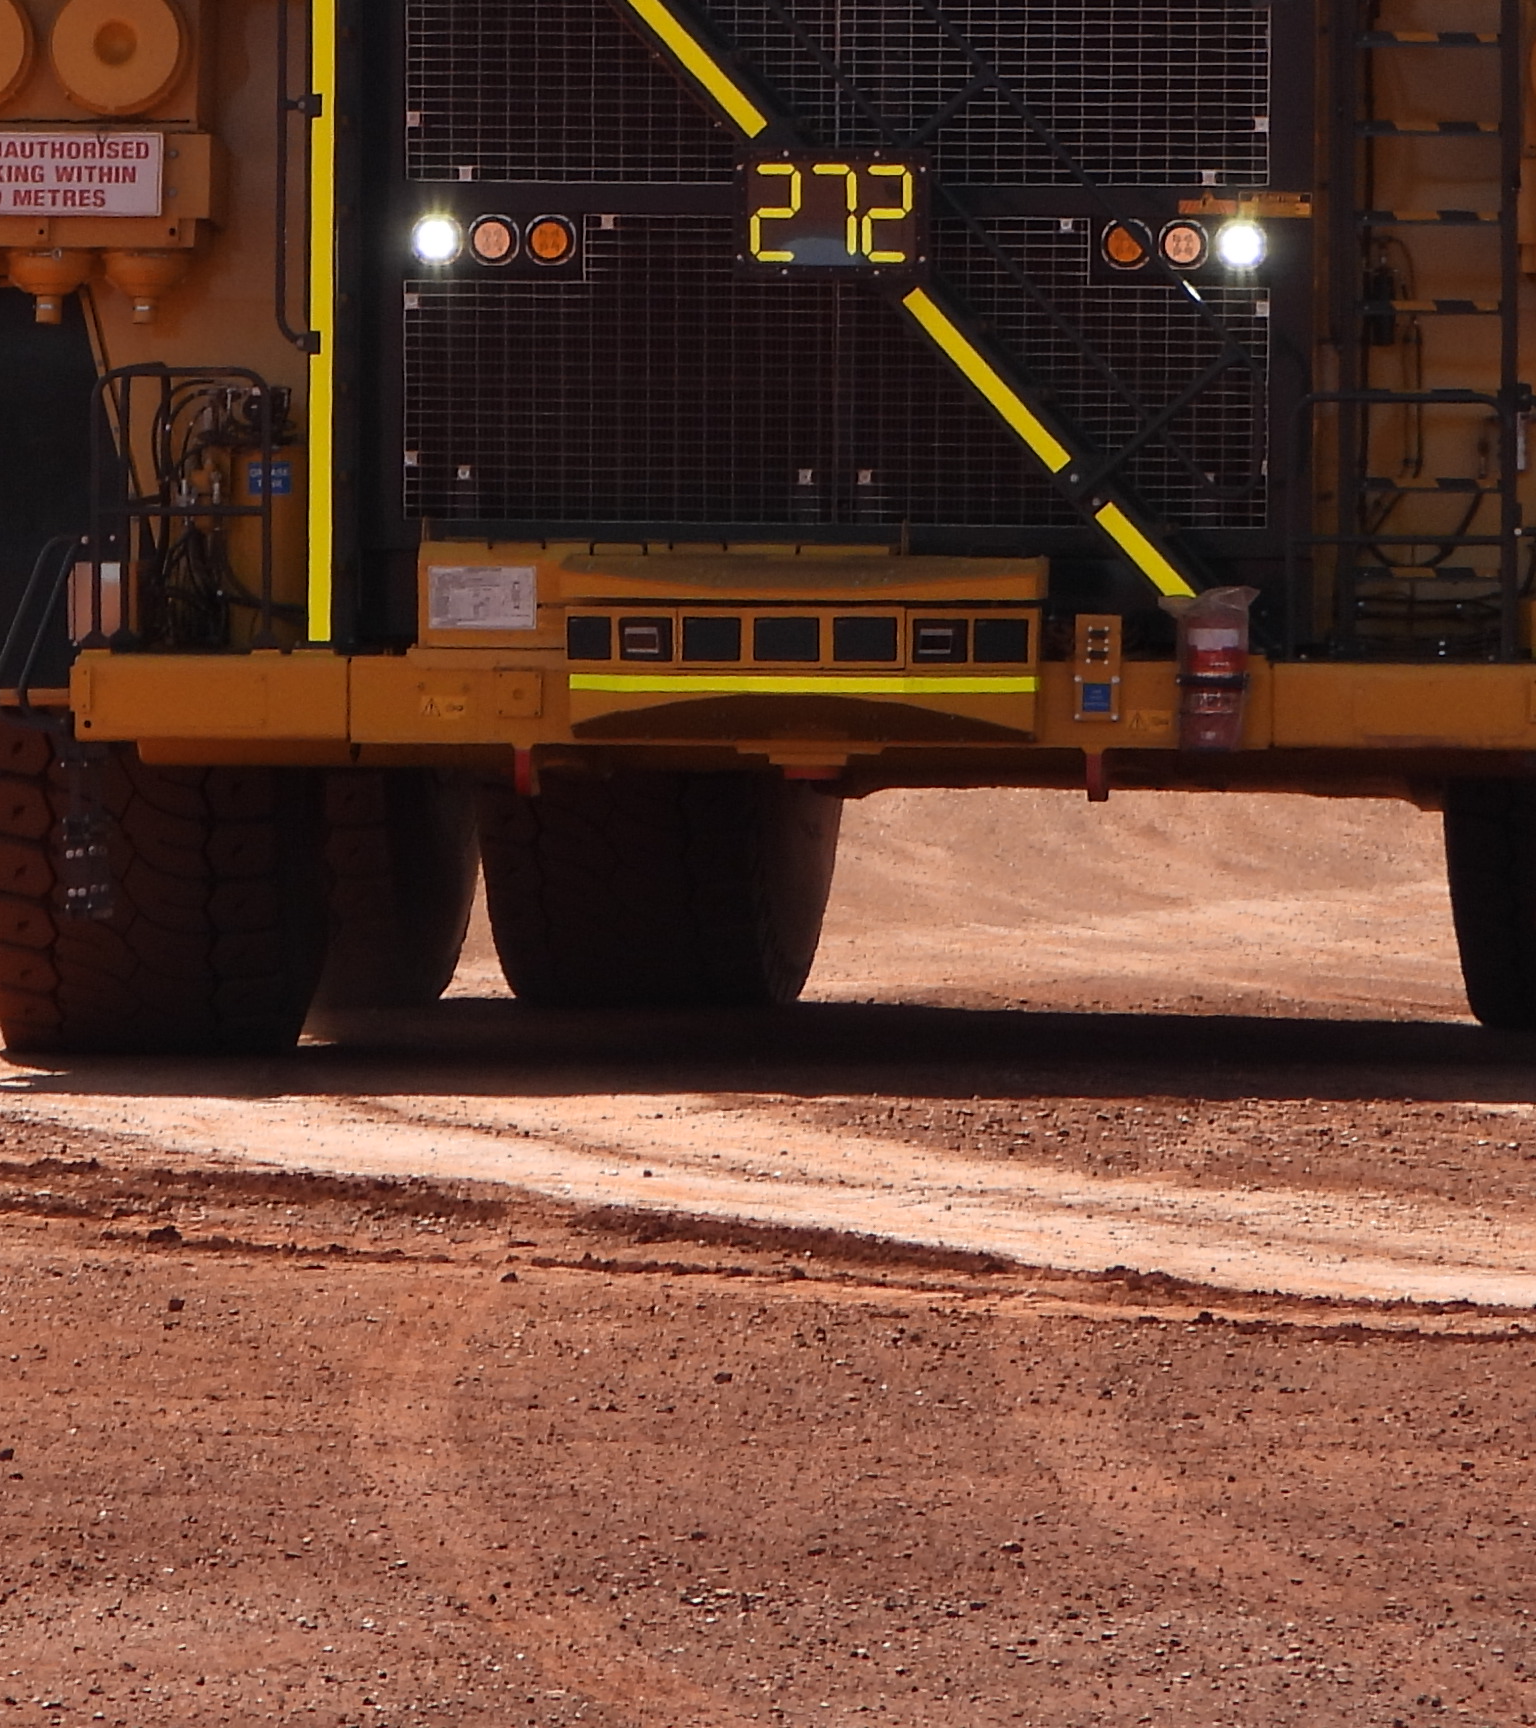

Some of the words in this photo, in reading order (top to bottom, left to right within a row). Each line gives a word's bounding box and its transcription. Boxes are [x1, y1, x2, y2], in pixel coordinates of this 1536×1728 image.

[55, 165, 137, 184] WITHIN
[13, 189, 106, 208] METRES
[749, 163, 913, 263] 272
